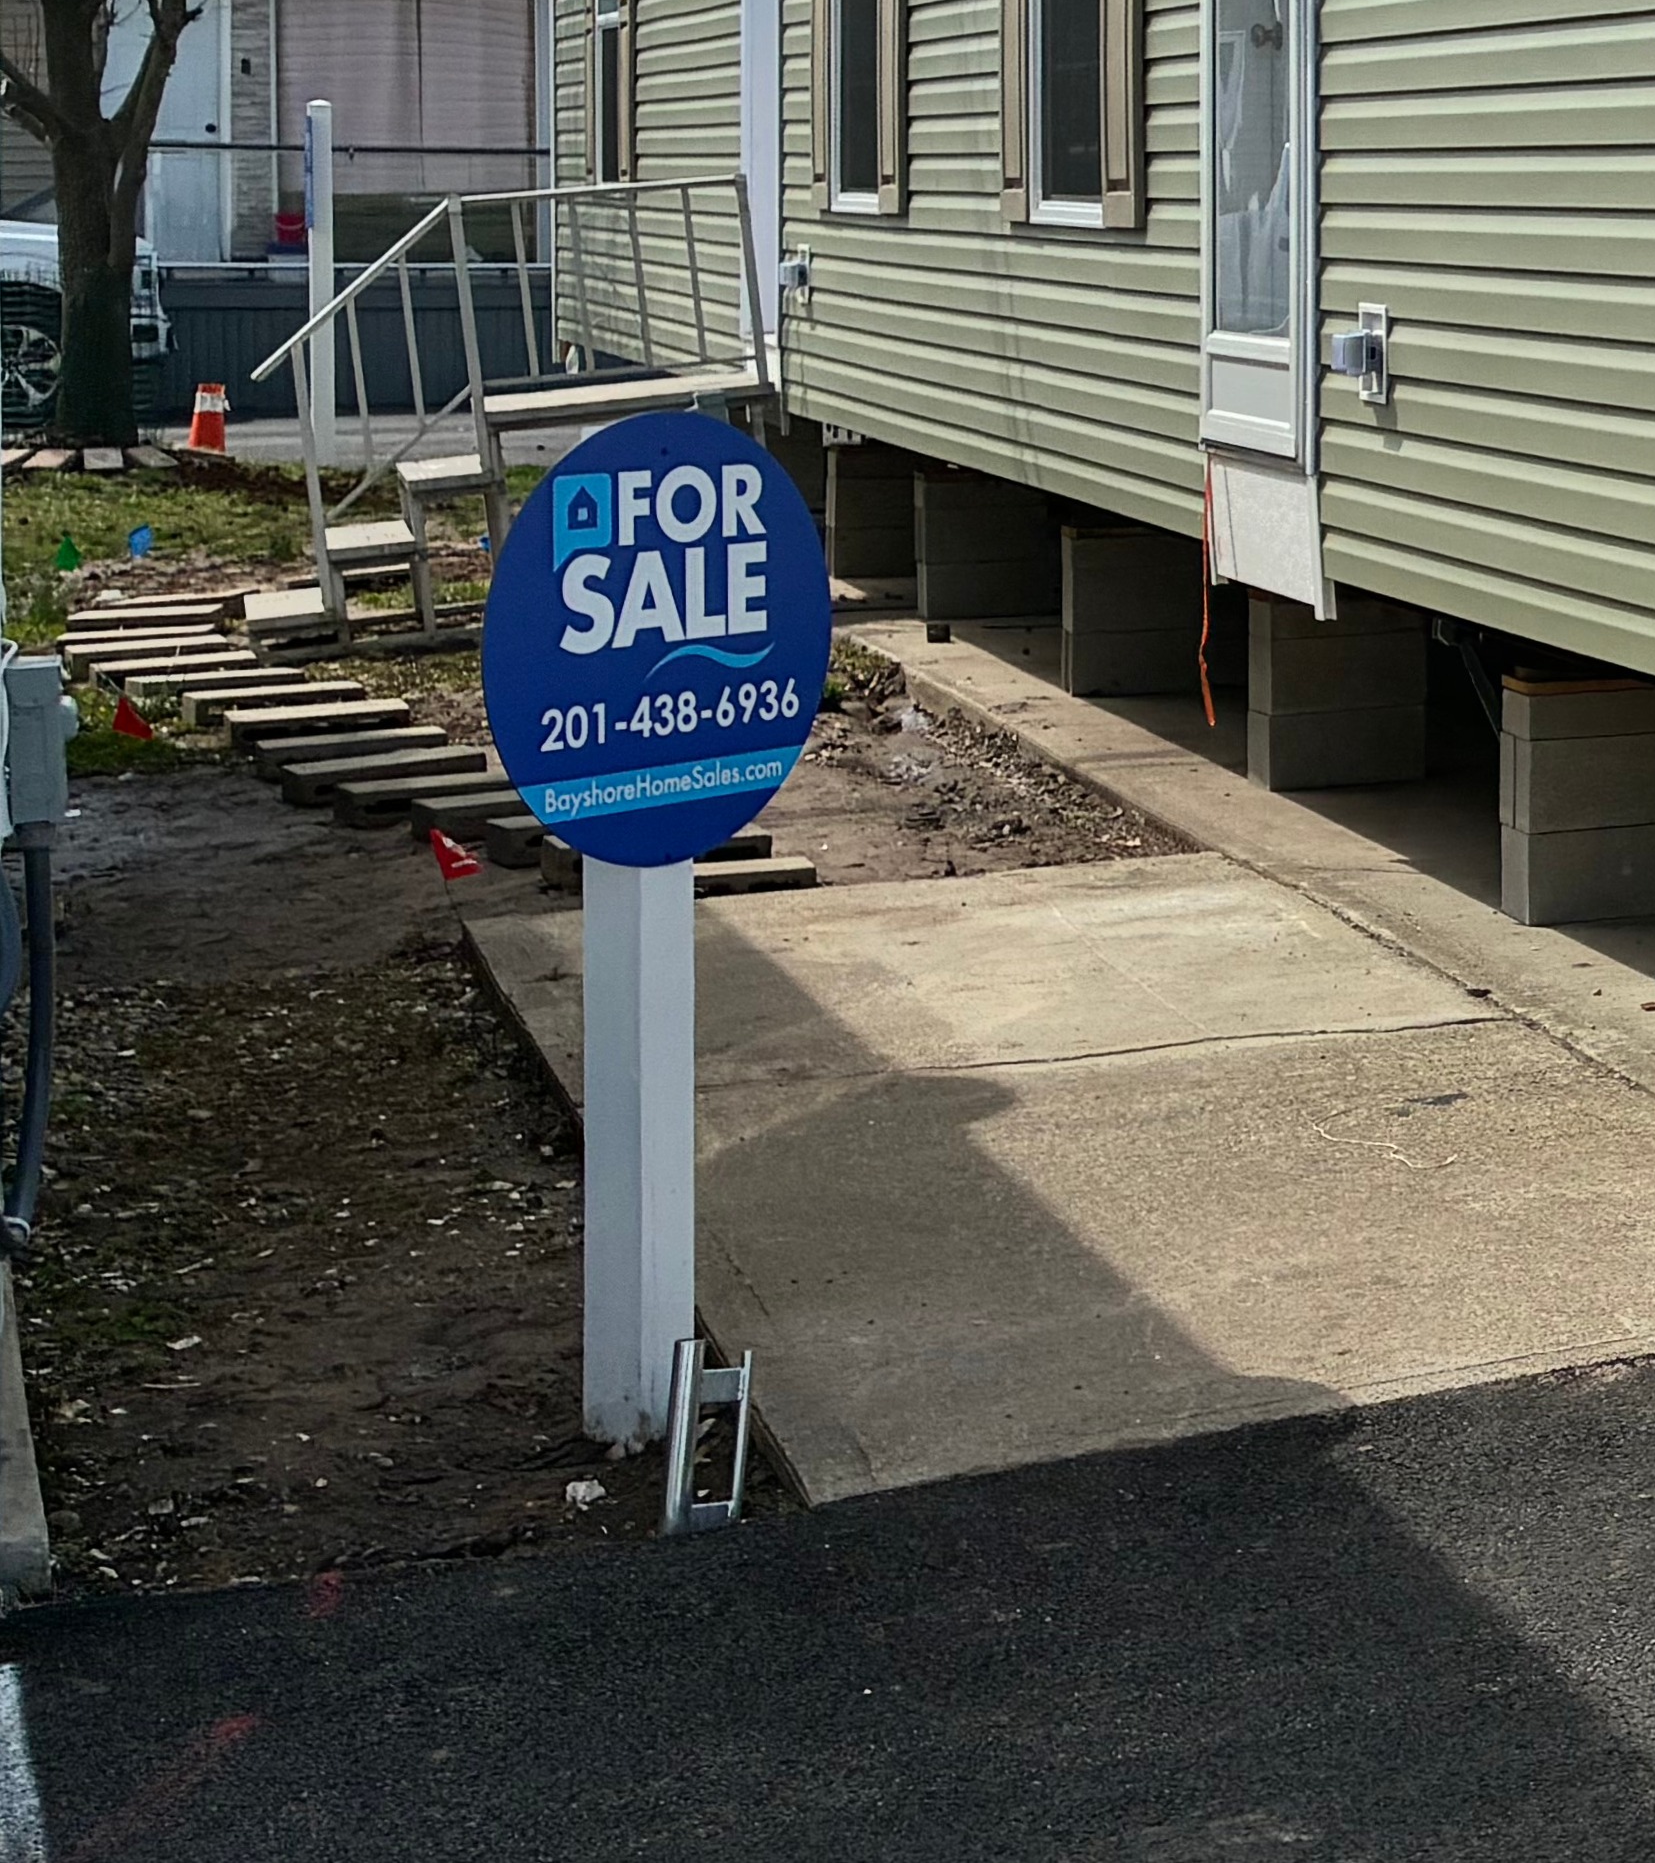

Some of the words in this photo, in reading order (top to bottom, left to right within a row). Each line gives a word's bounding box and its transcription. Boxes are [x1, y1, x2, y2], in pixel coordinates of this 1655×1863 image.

[618, 464, 767, 546] FOR
[559, 541, 768, 655] SALE
[540, 678, 800, 752] 201-438-6936
[544, 759, 782, 814] BayshoreHomeSales.com
